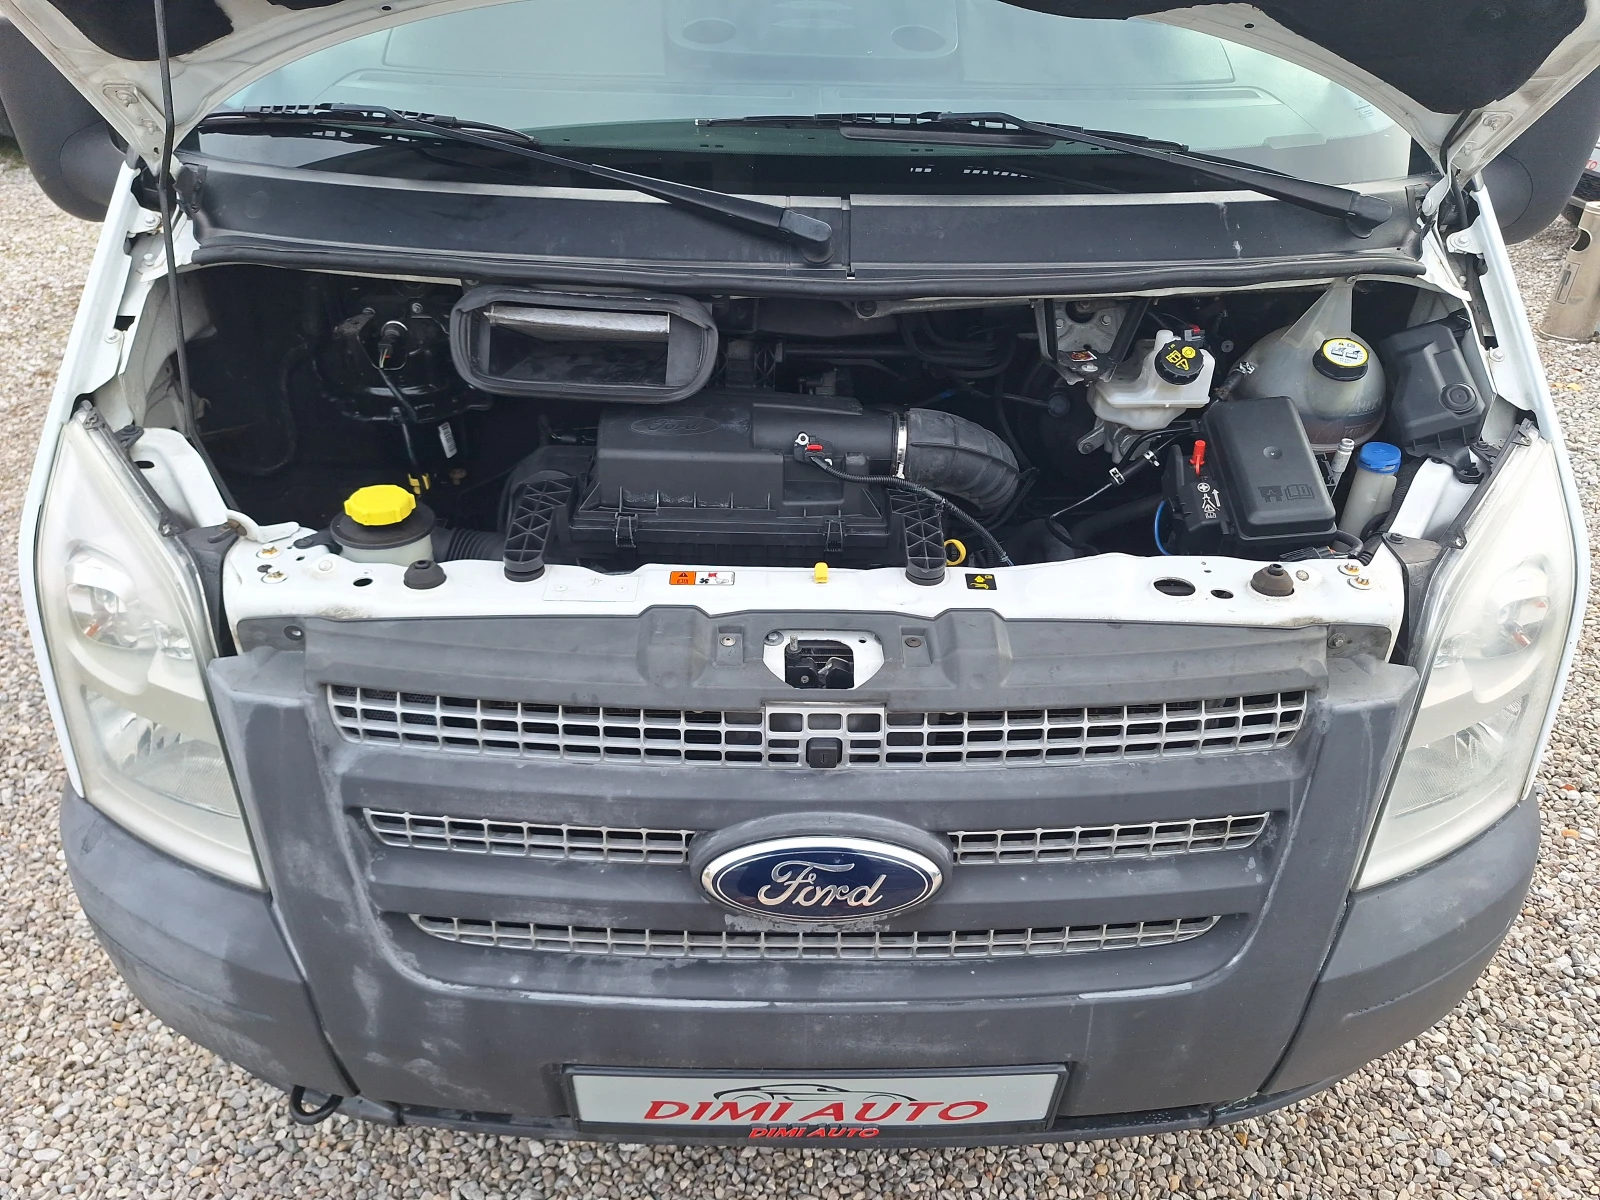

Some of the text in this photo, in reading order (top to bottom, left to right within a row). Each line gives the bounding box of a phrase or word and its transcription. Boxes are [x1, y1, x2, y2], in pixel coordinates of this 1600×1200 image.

[648, 418, 702, 431] Ford
[757, 860, 888, 907] Ford
[643, 1101, 989, 1121] DIMI AUTO
[749, 1127, 880, 1139] DIMI AUTO
